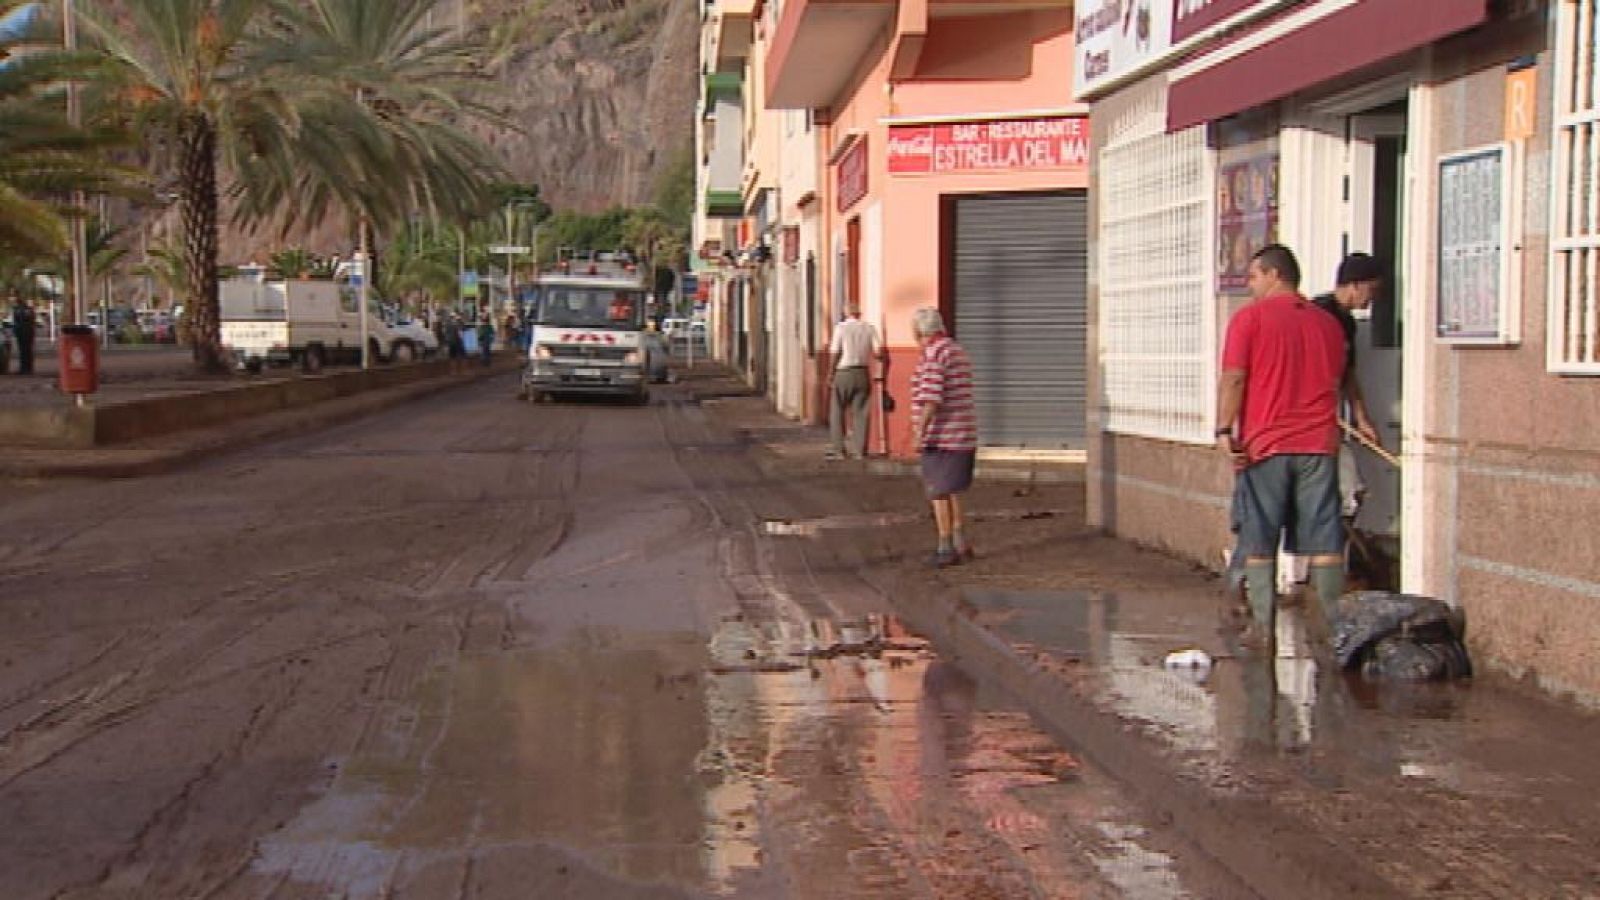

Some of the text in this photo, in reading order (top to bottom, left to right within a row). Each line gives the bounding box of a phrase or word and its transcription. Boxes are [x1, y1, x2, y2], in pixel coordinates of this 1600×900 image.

[1512, 80, 1527, 130] R
[952, 124, 978, 142] BAR
[989, 118, 1080, 139] RESTAURANTE
[936, 141, 1021, 170] ESTRELLA
[1024, 139, 1055, 166] DEL
